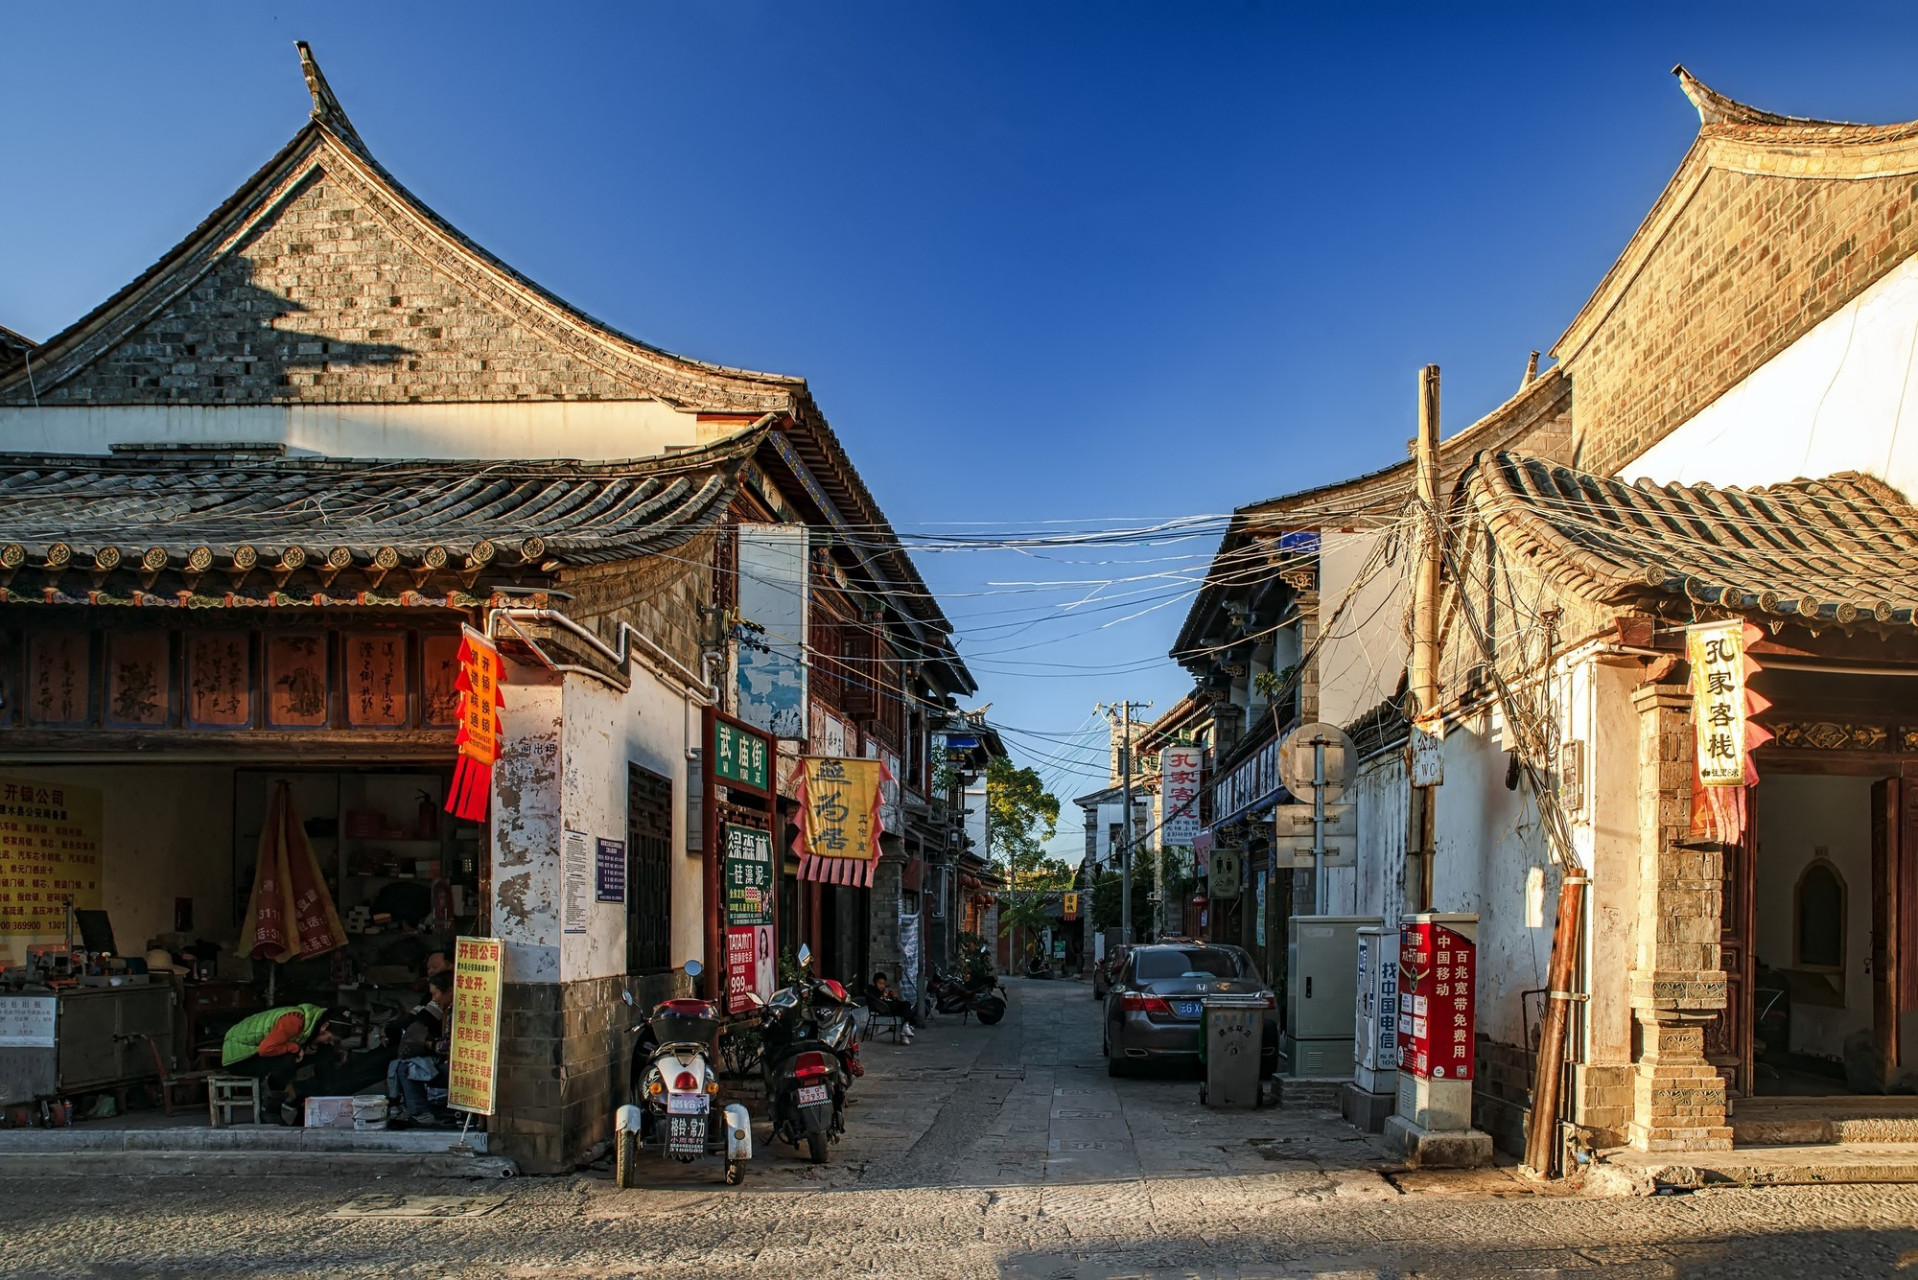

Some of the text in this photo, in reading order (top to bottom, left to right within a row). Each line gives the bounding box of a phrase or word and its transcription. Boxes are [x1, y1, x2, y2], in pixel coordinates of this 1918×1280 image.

[1704, 637, 1735, 760] 孔家客栈
[719, 726, 763, 771] 武庙街
[1421, 762, 1437, 777] WC
[4, 783, 64, 806] 开锁公司
[1168, 753, 1198, 819] 孔家客栈
[728, 831, 768, 862] 绿森林
[734, 864, 764, 885] 硅藻泥
[459, 943, 499, 961] 开锁公司
[1435, 935, 1451, 997] 中国移动
[731, 976, 745, 993] 999
[458, 993, 493, 1010] 汽车锁
[1379, 962, 1397, 1049] 找中国电信
[1453, 950, 1470, 1059] 百兆宽带免费用
[457, 1011, 492, 1027] 家用锁
[457, 1027, 490, 1044] 保险柜锁
